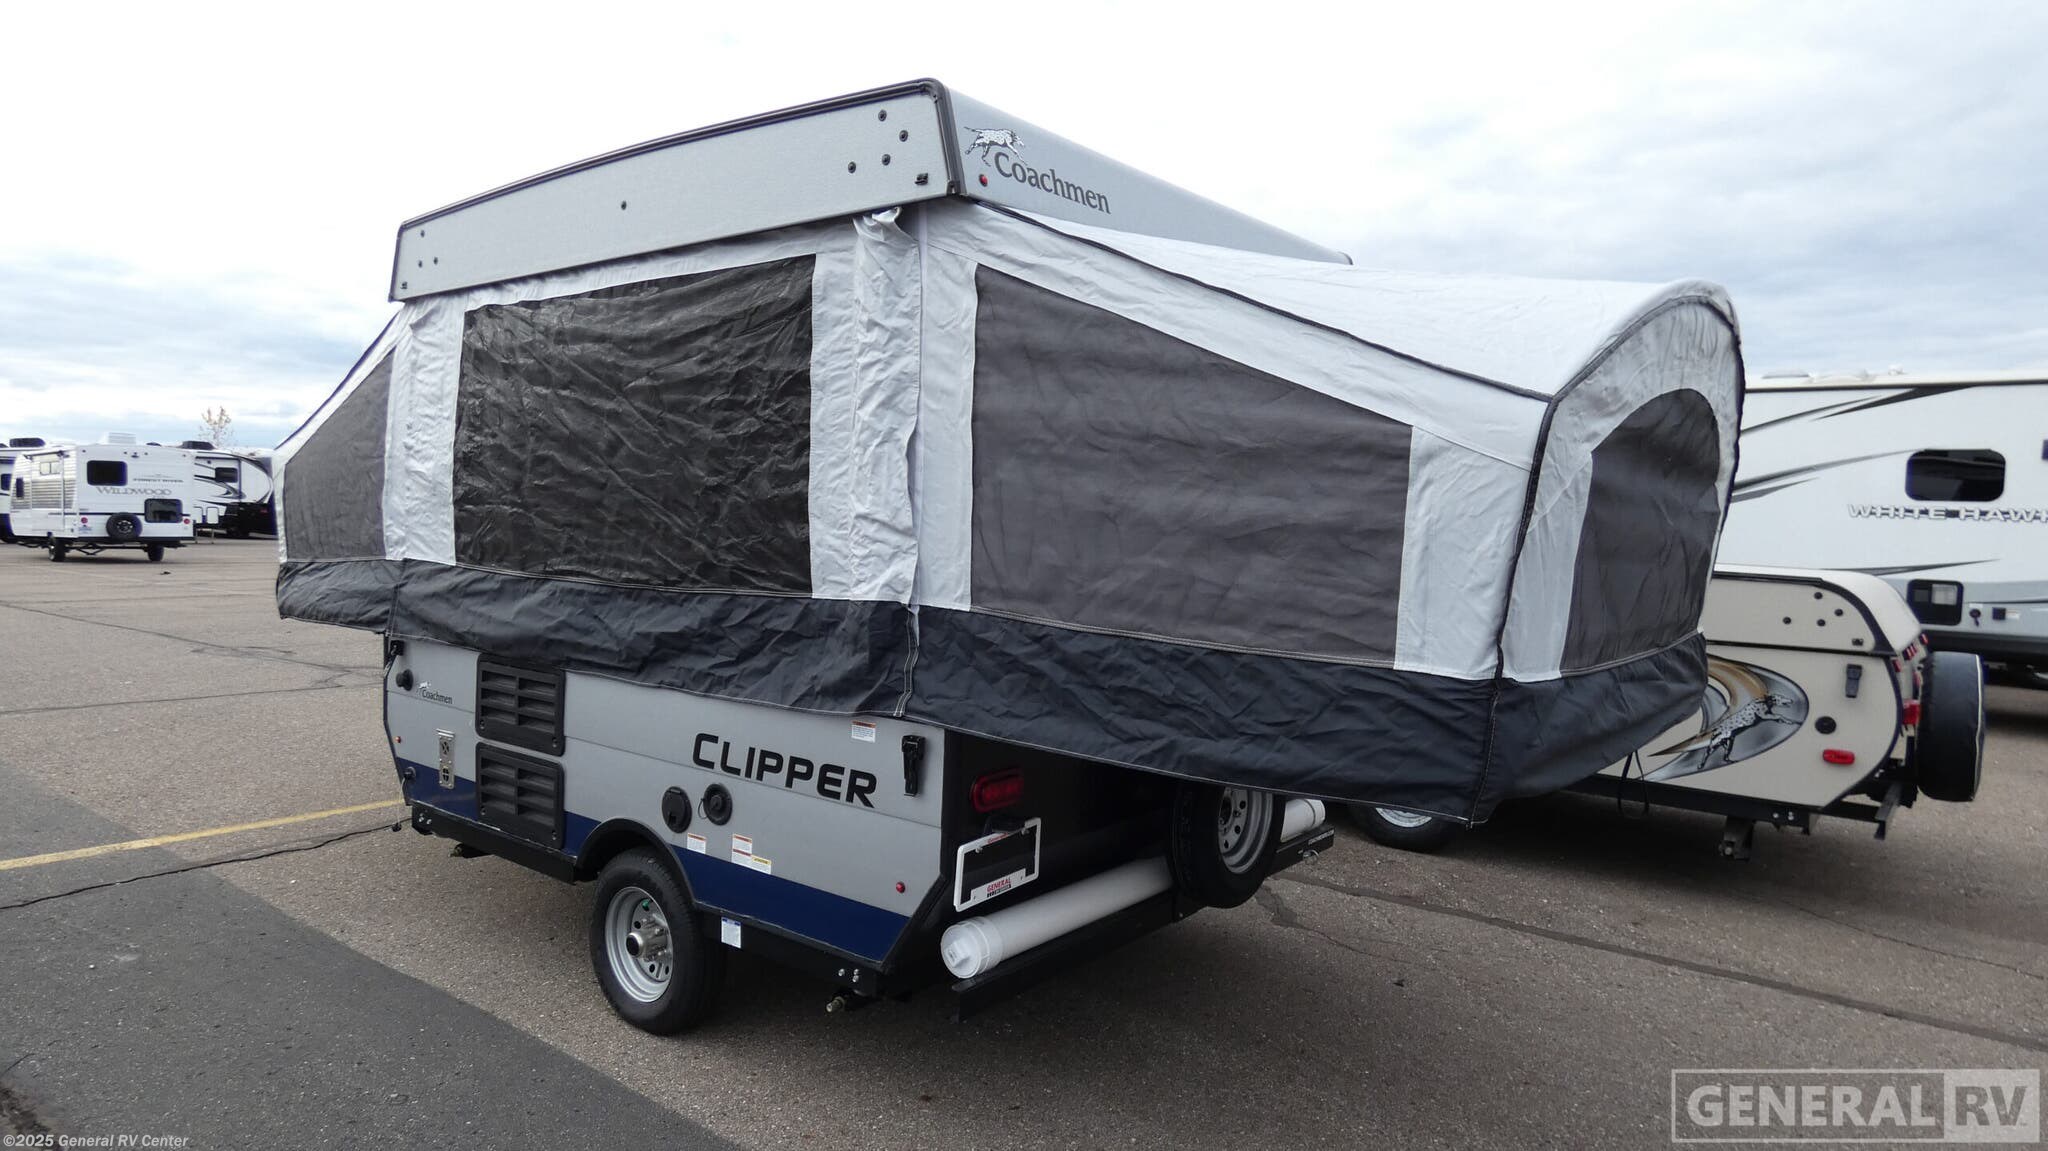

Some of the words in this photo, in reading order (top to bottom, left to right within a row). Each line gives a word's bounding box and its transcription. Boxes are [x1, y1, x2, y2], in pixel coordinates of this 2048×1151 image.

[994, 151, 1112, 215] Coachmen
[96, 486, 172, 496] WILDWOOD
[1848, 503, 1947, 521] WHITE
[421, 689, 453, 705] Coachmen
[692, 732, 878, 809] CLIPPER
